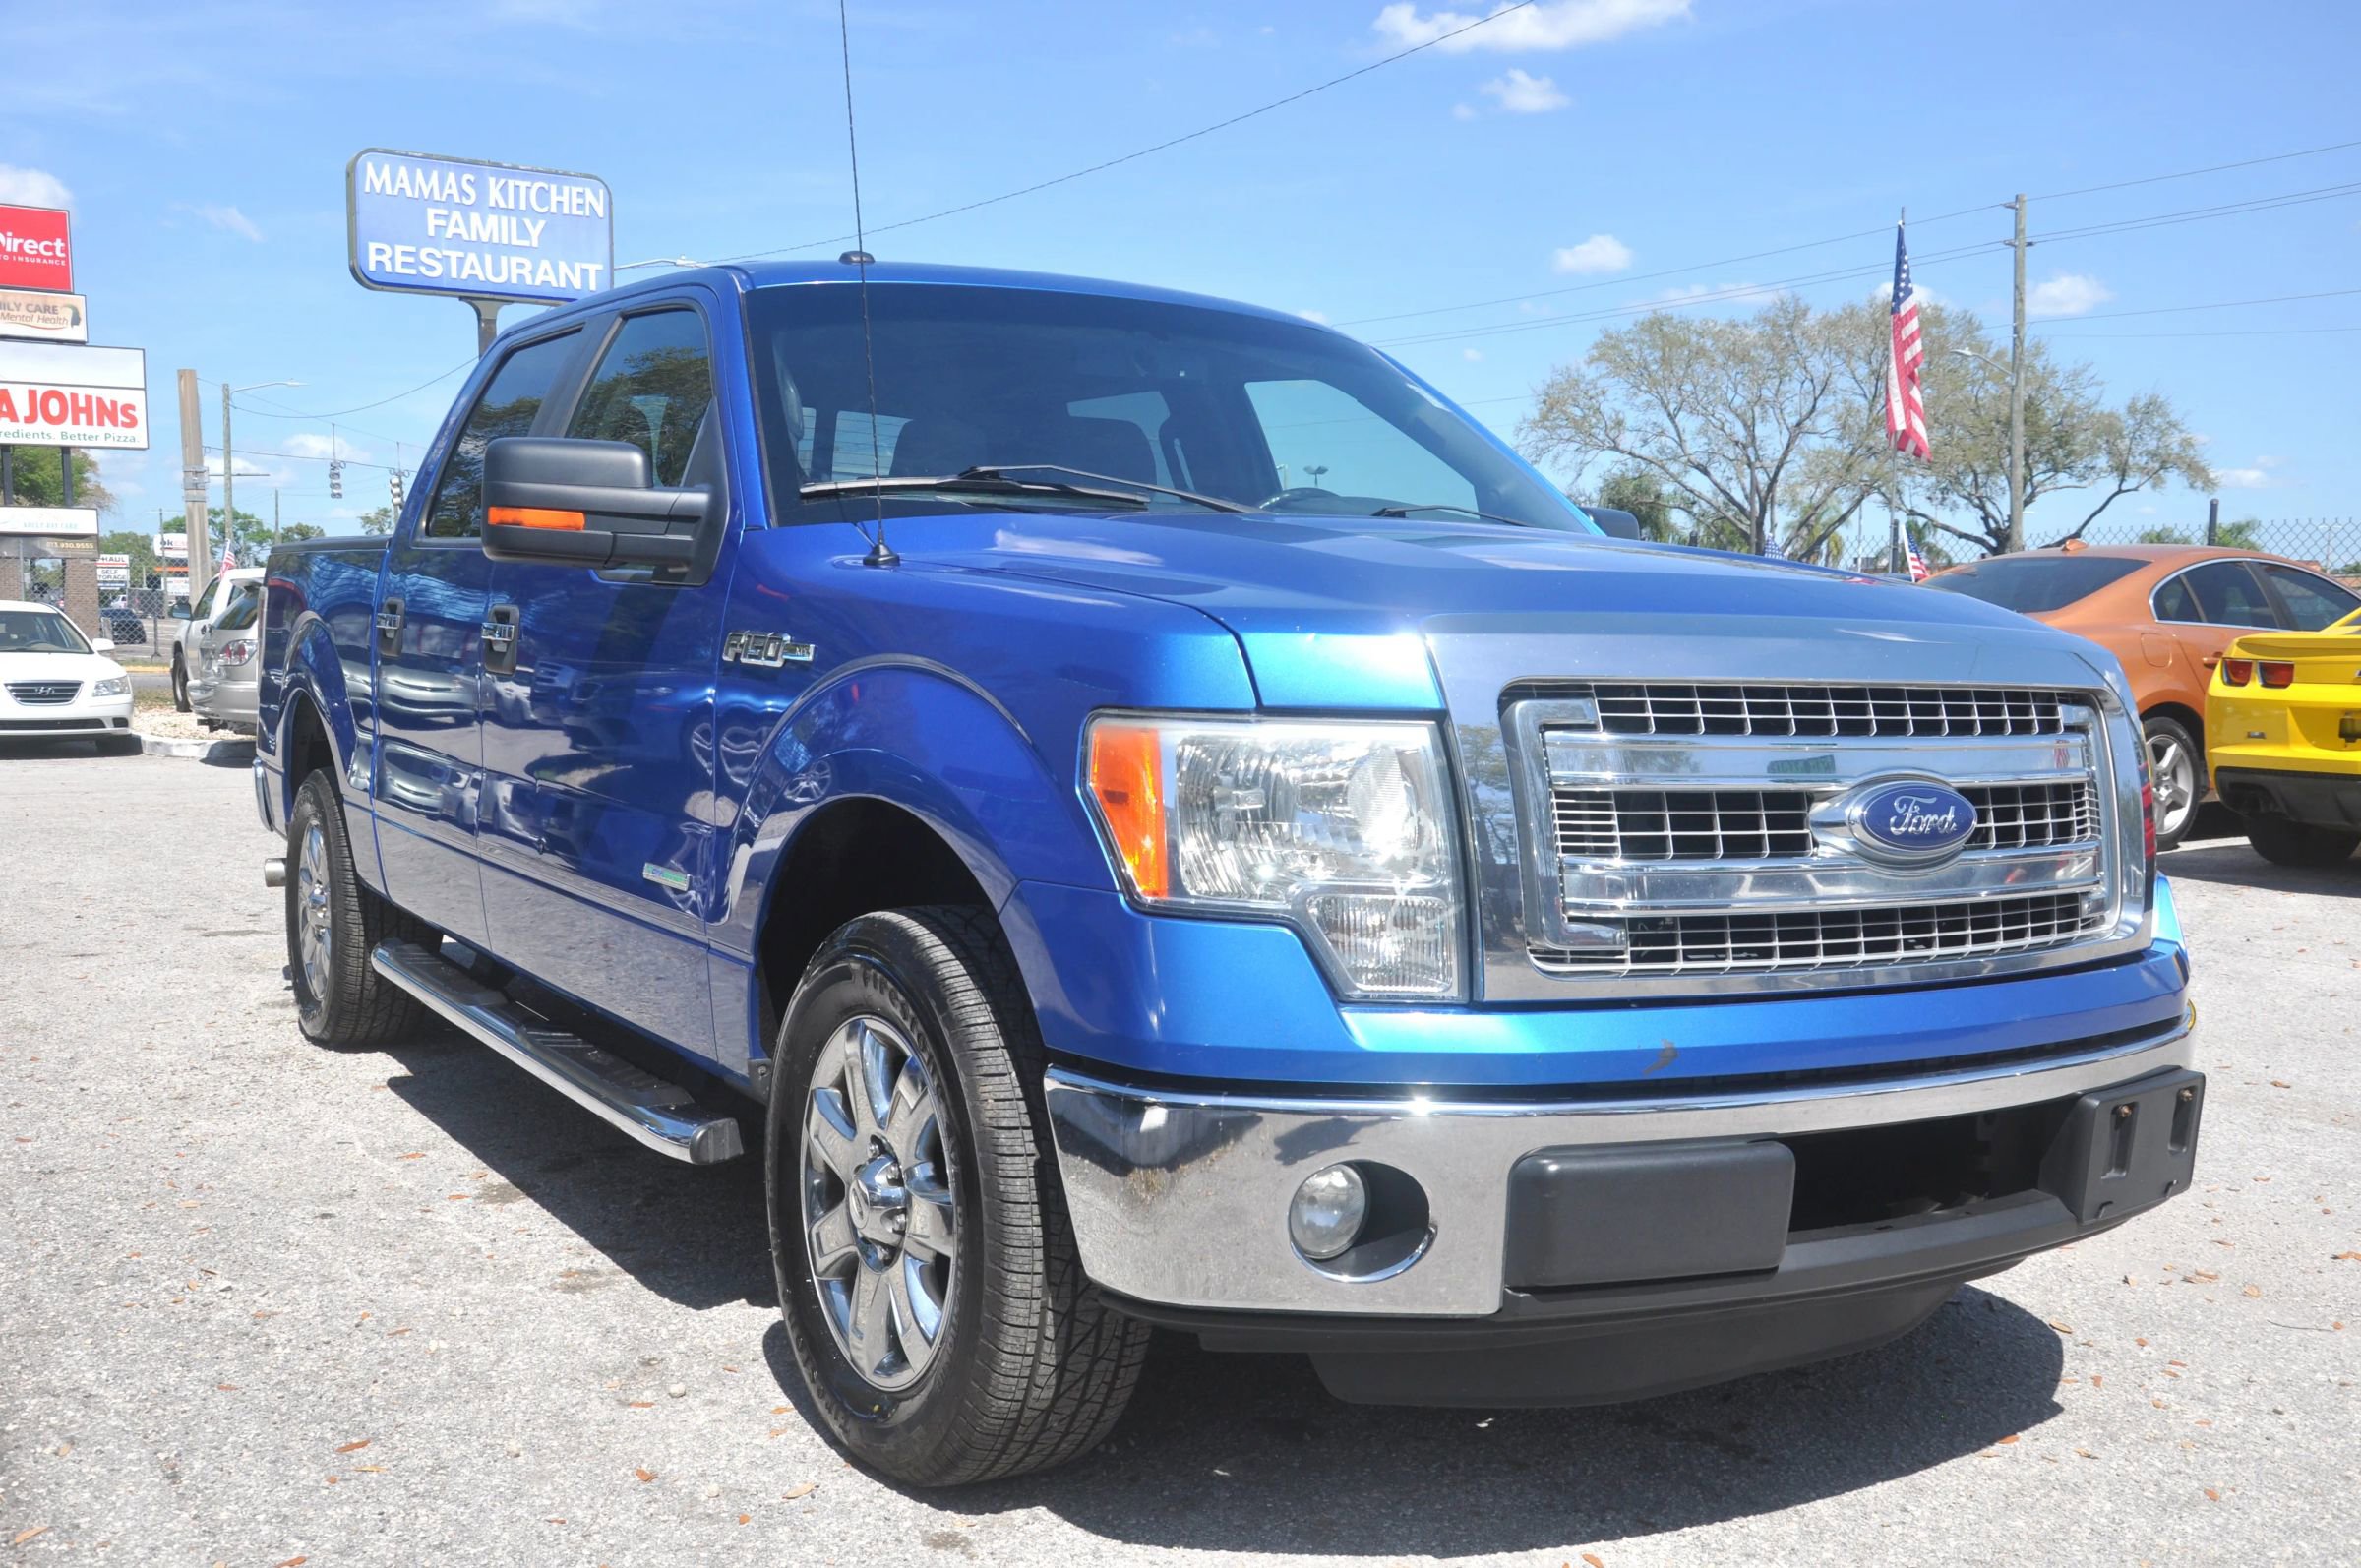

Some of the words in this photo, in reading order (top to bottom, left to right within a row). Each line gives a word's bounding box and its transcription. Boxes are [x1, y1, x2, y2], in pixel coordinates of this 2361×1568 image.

[364, 161, 477, 206] MAMAS
[488, 176, 604, 219] KITCHEN
[426, 208, 547, 248] FAMILY
[13, 255, 66, 267] INSURANCE
[367, 242, 604, 292] RESTAURANT
[26, 303, 59, 315] CARE
[37, 315, 69, 326] Health
[24, 389, 138, 428] JOHNS
[60, 431, 99, 442] Better
[104, 433, 140, 443] Pizza.
[1889, 795, 1958, 836] Ford
